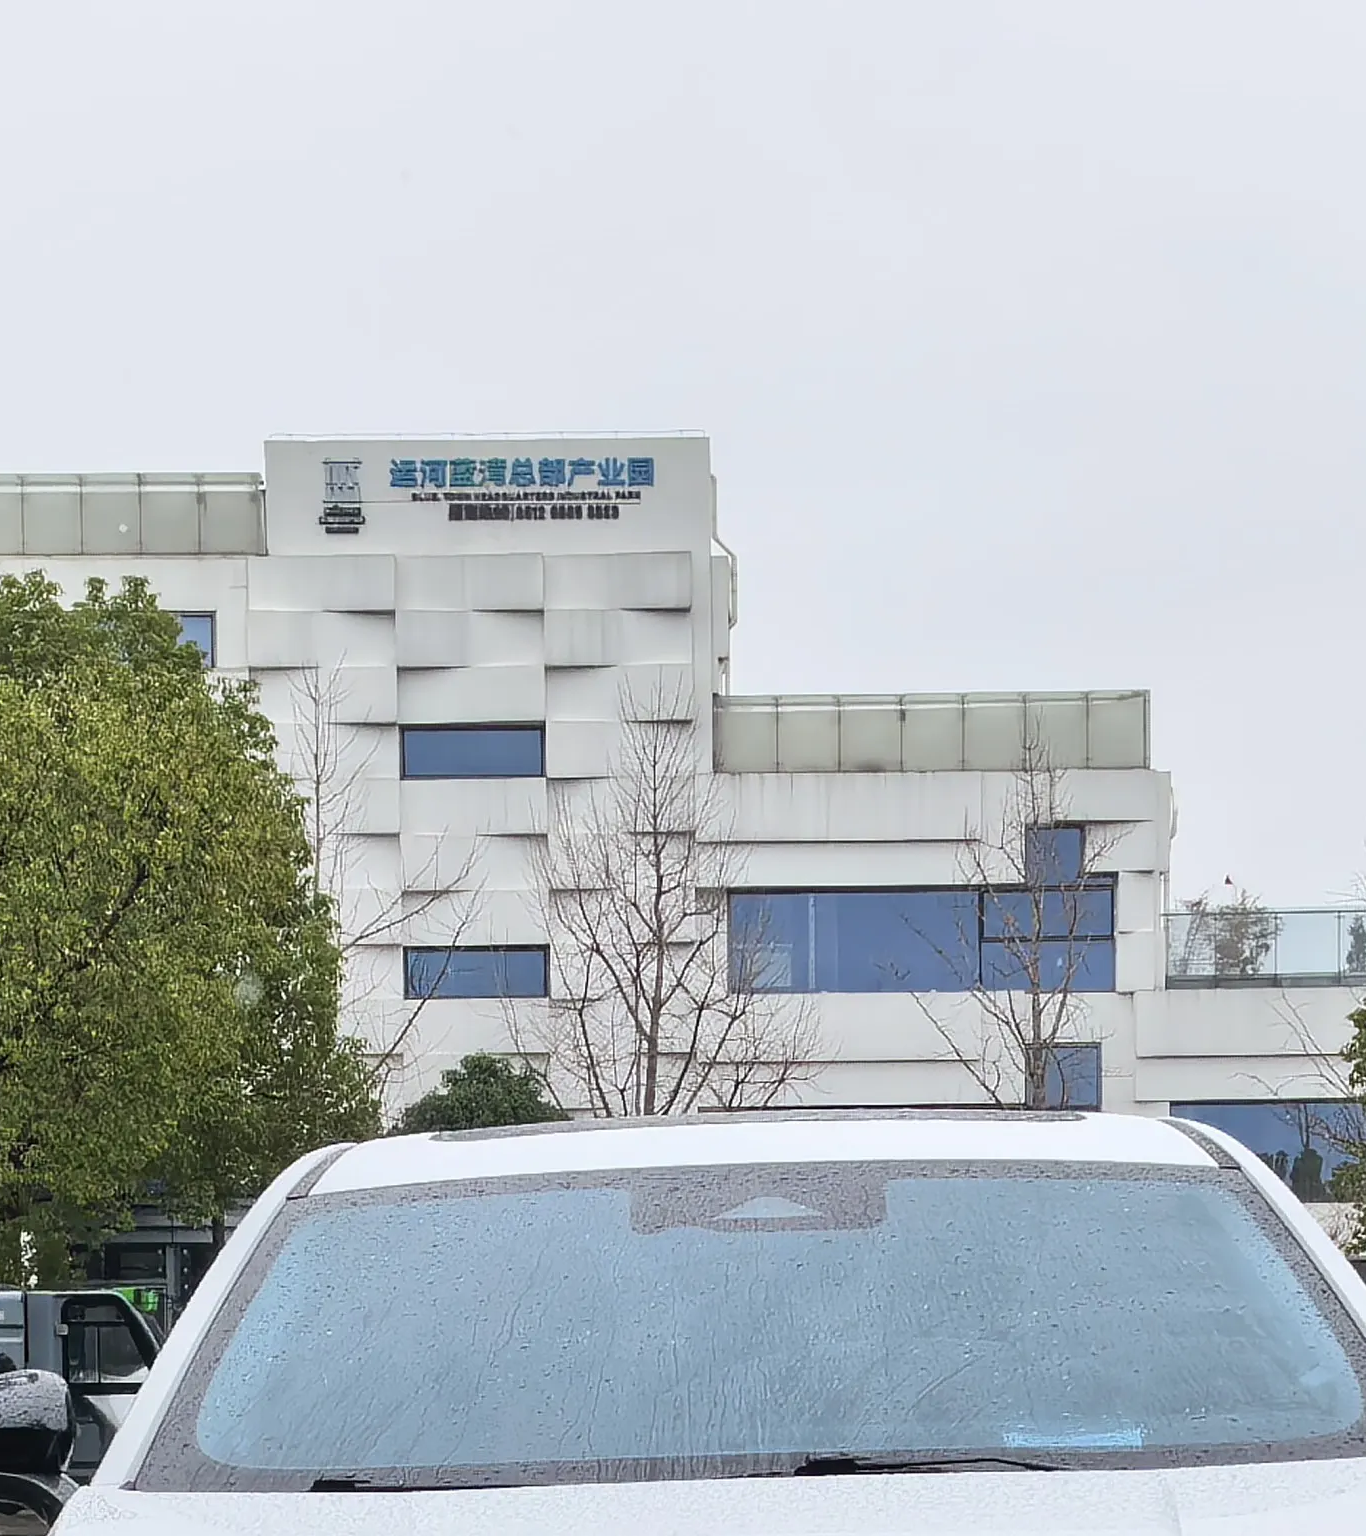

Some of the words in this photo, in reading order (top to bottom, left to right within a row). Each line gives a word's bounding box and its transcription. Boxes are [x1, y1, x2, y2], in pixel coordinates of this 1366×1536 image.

[389, 457, 655, 488] 运河蓝湾总部产业园
